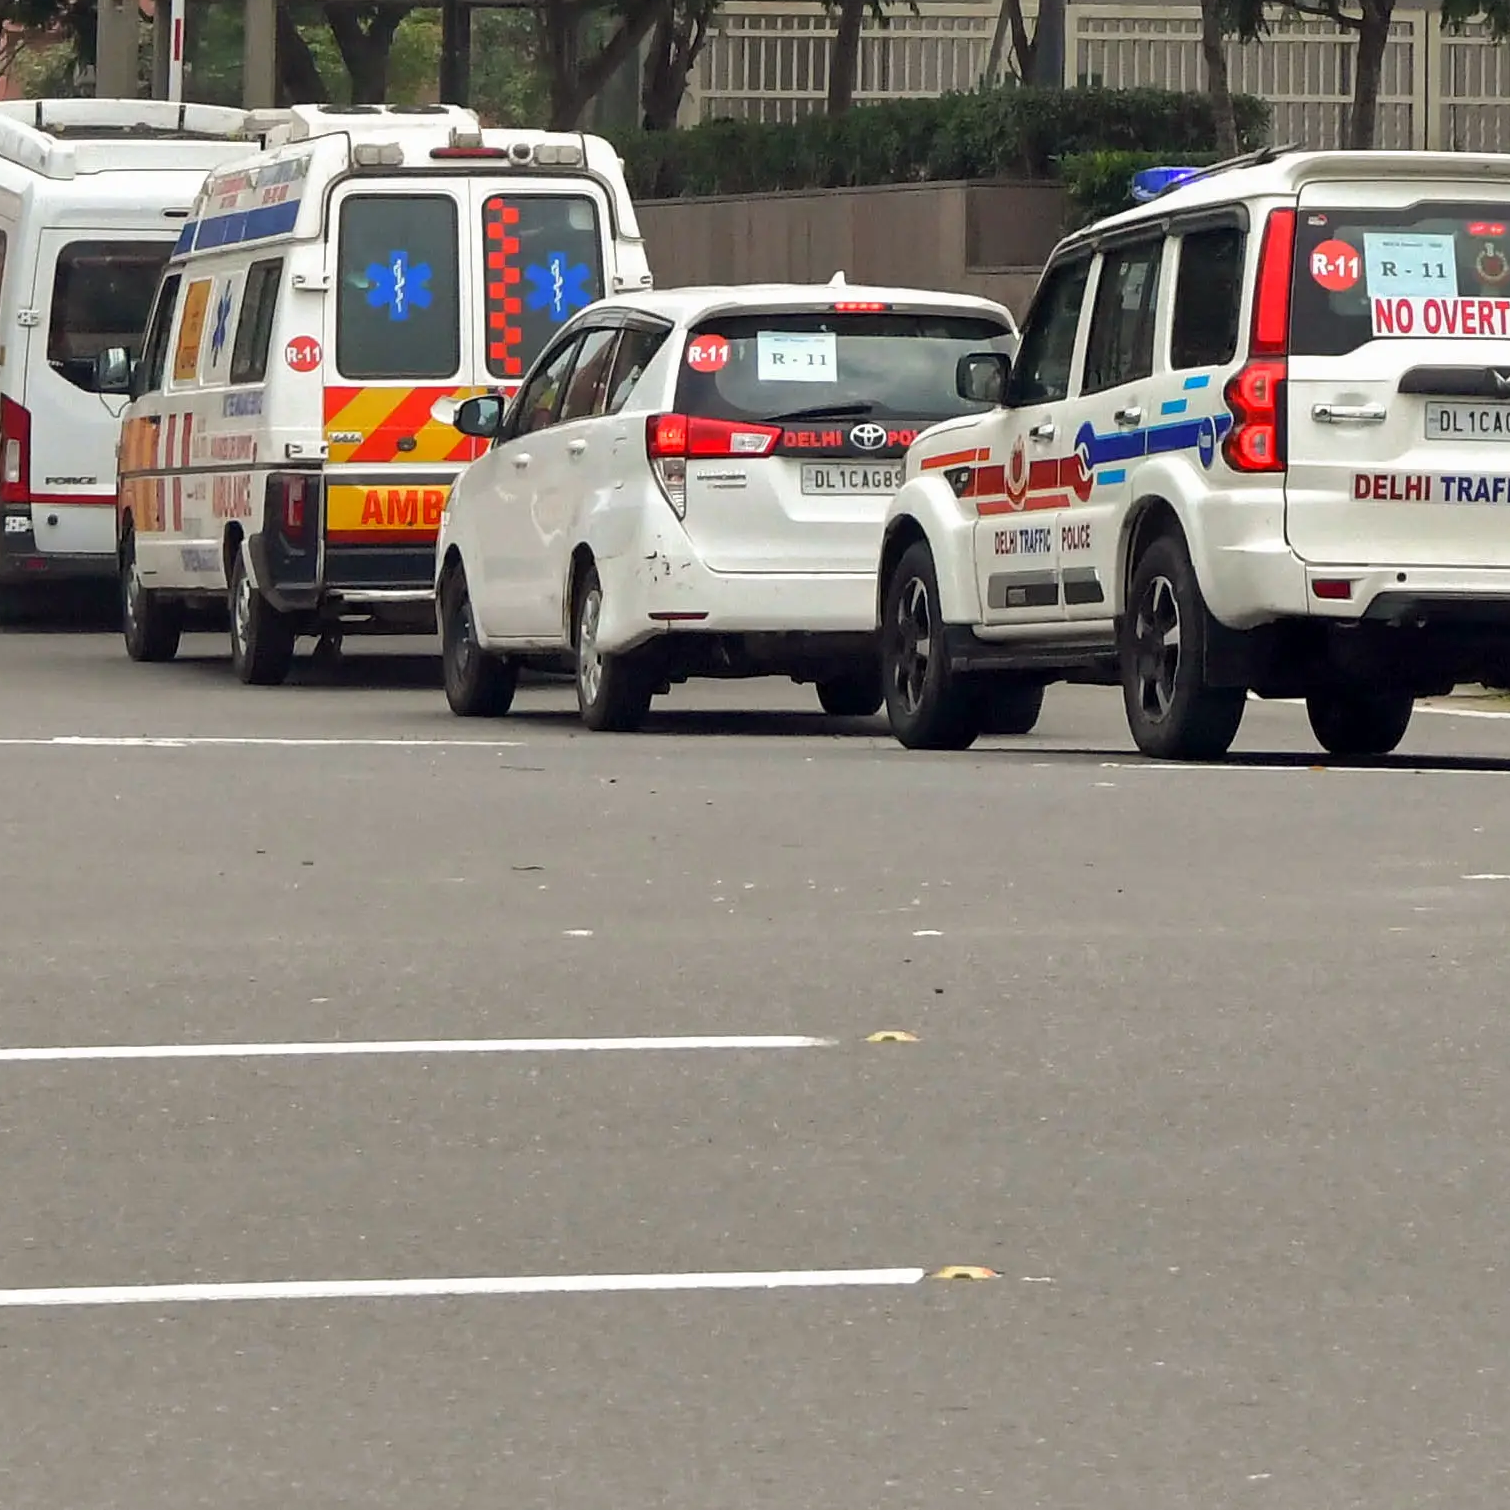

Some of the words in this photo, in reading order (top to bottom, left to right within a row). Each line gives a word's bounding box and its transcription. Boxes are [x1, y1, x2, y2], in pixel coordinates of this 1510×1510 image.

[1311, 252, 1361, 279] R-11
[1374, 298, 1414, 334] NO
[286, 345, 322, 363] R-11
[688, 344, 730, 364] R-11
[783, 430, 843, 448] DELHI
[1353, 473, 1432, 501] DELHI
[994, 530, 1018, 555] DELHI
[1019, 527, 1052, 554] TRAFFIC
[1061, 524, 1091, 552] POLICE
